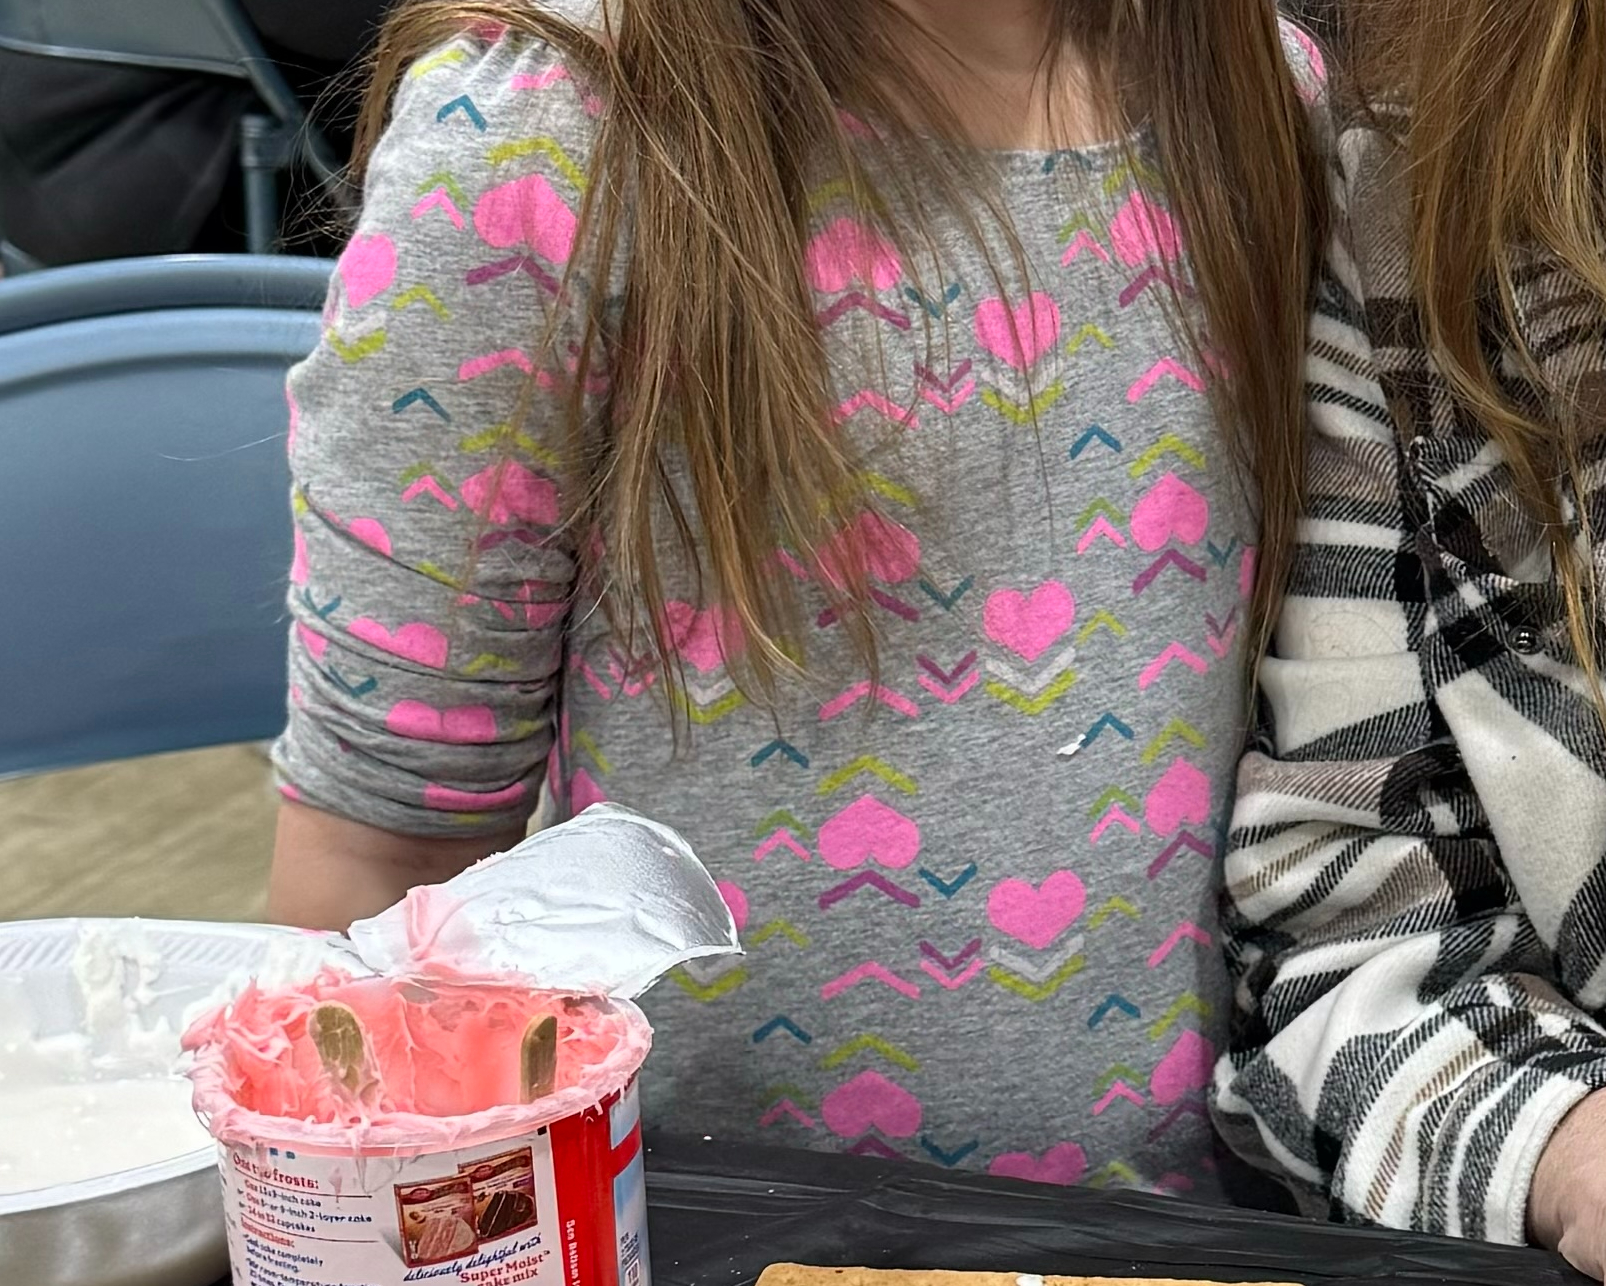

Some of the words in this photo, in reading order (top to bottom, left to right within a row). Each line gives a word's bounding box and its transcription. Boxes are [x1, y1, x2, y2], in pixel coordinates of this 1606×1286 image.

[273, 1169, 319, 1190] frosts:
[309, 1210, 345, 1223] 2-layer
[277, 1250, 324, 1267] completely
[403, 1262, 463, 1282] deliciously
[465, 1241, 518, 1269] delightful
[512, 1268, 539, 1283] mix
